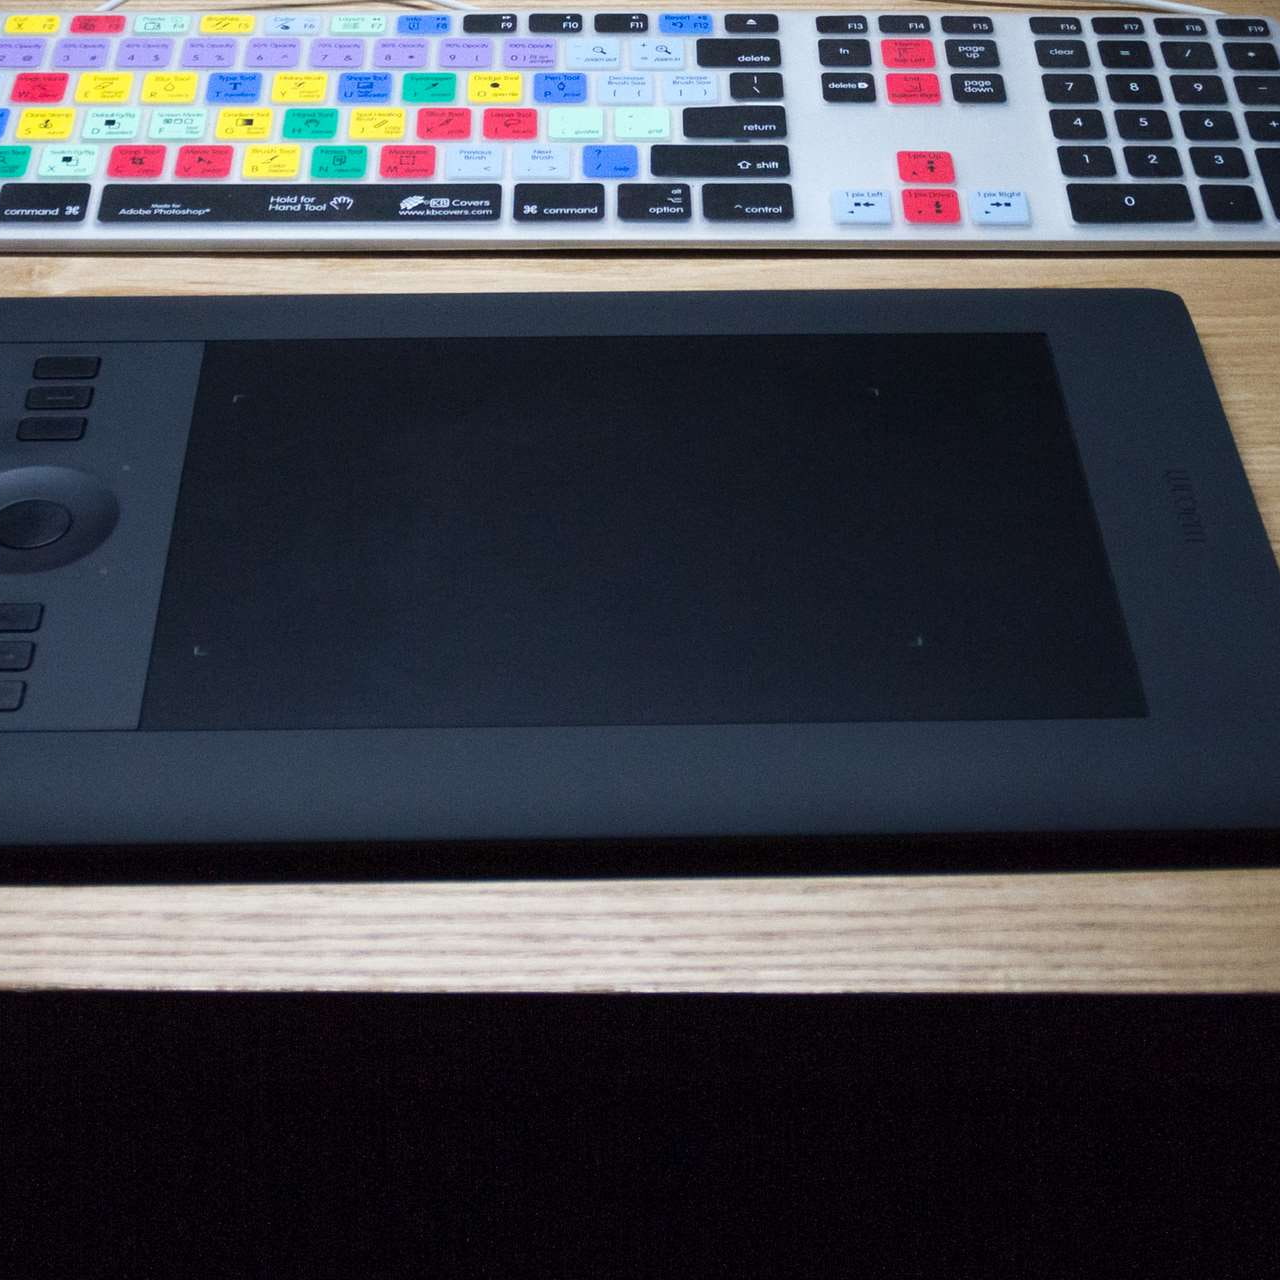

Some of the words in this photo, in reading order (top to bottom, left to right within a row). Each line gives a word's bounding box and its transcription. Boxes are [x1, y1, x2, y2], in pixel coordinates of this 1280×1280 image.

[1049, 48, 1074, 56] clear
[1064, 82, 1074, 91] 7
[1129, 82, 1140, 92] 8
[1193, 83, 1203, 92] 9
[1073, 118, 1083, 127] 4
[1139, 118, 1148, 127] 5
[1204, 118, 1214, 128] 6
[1083, 154, 1090, 164] 1
[1148, 154, 1159, 164] 2
[1214, 154, 1224, 164] 3
[756, 161, 779, 169] shift
[270, 196, 298, 204] Hold
[299, 196, 316, 204] for
[431, 199, 450, 207] KB
[1124, 196, 1135, 206] 0
[4, 207, 60, 216] command
[269, 203, 302, 211] Hand
[304, 203, 327, 211] Tool
[543, 206, 598, 214] command
[649, 206, 684, 215] option
[745, 206, 782, 214] control
